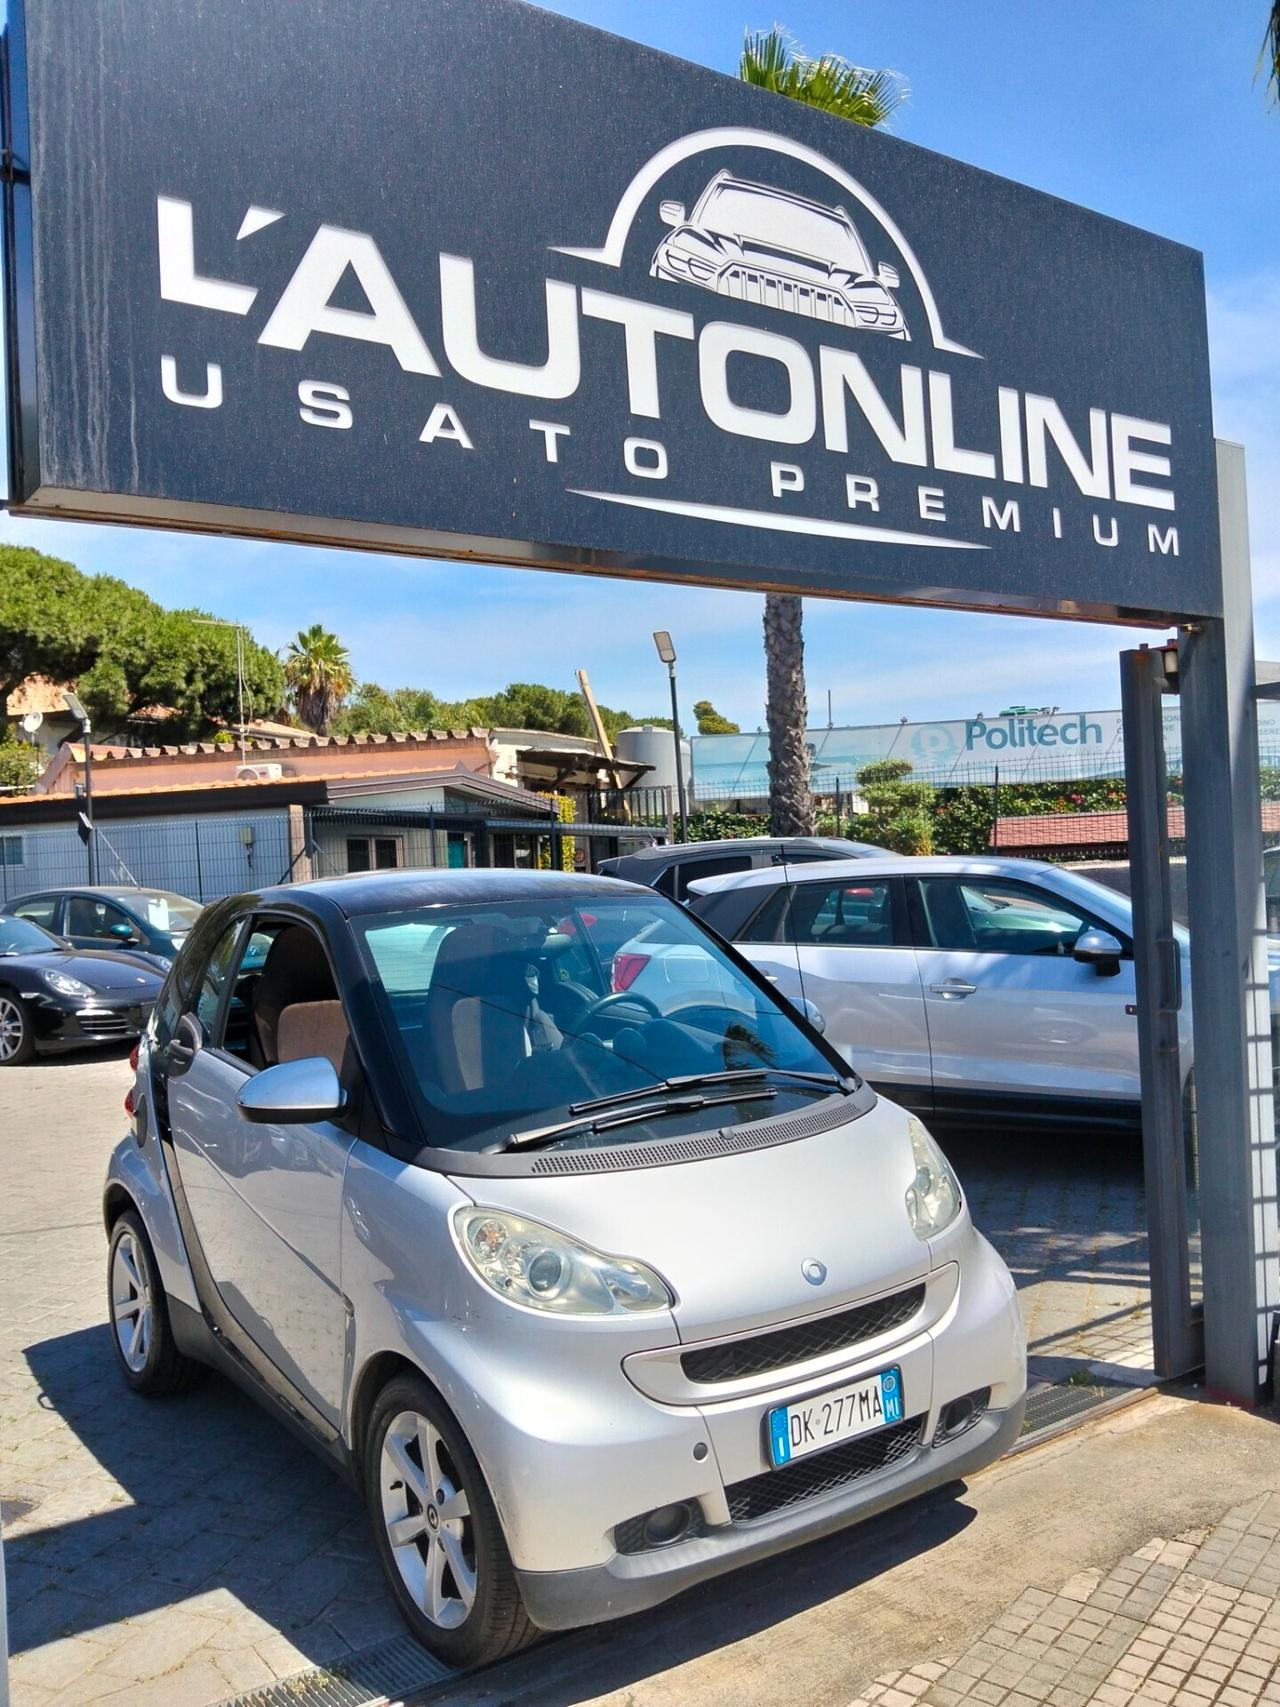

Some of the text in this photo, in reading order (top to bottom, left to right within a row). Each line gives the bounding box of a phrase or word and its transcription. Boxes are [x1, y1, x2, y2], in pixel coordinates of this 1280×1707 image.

[157, 194, 1177, 511] L'AUTONLINE
[160, 353, 1180, 556] USATO PREMIUM
[965, 714, 1102, 751] Politech
